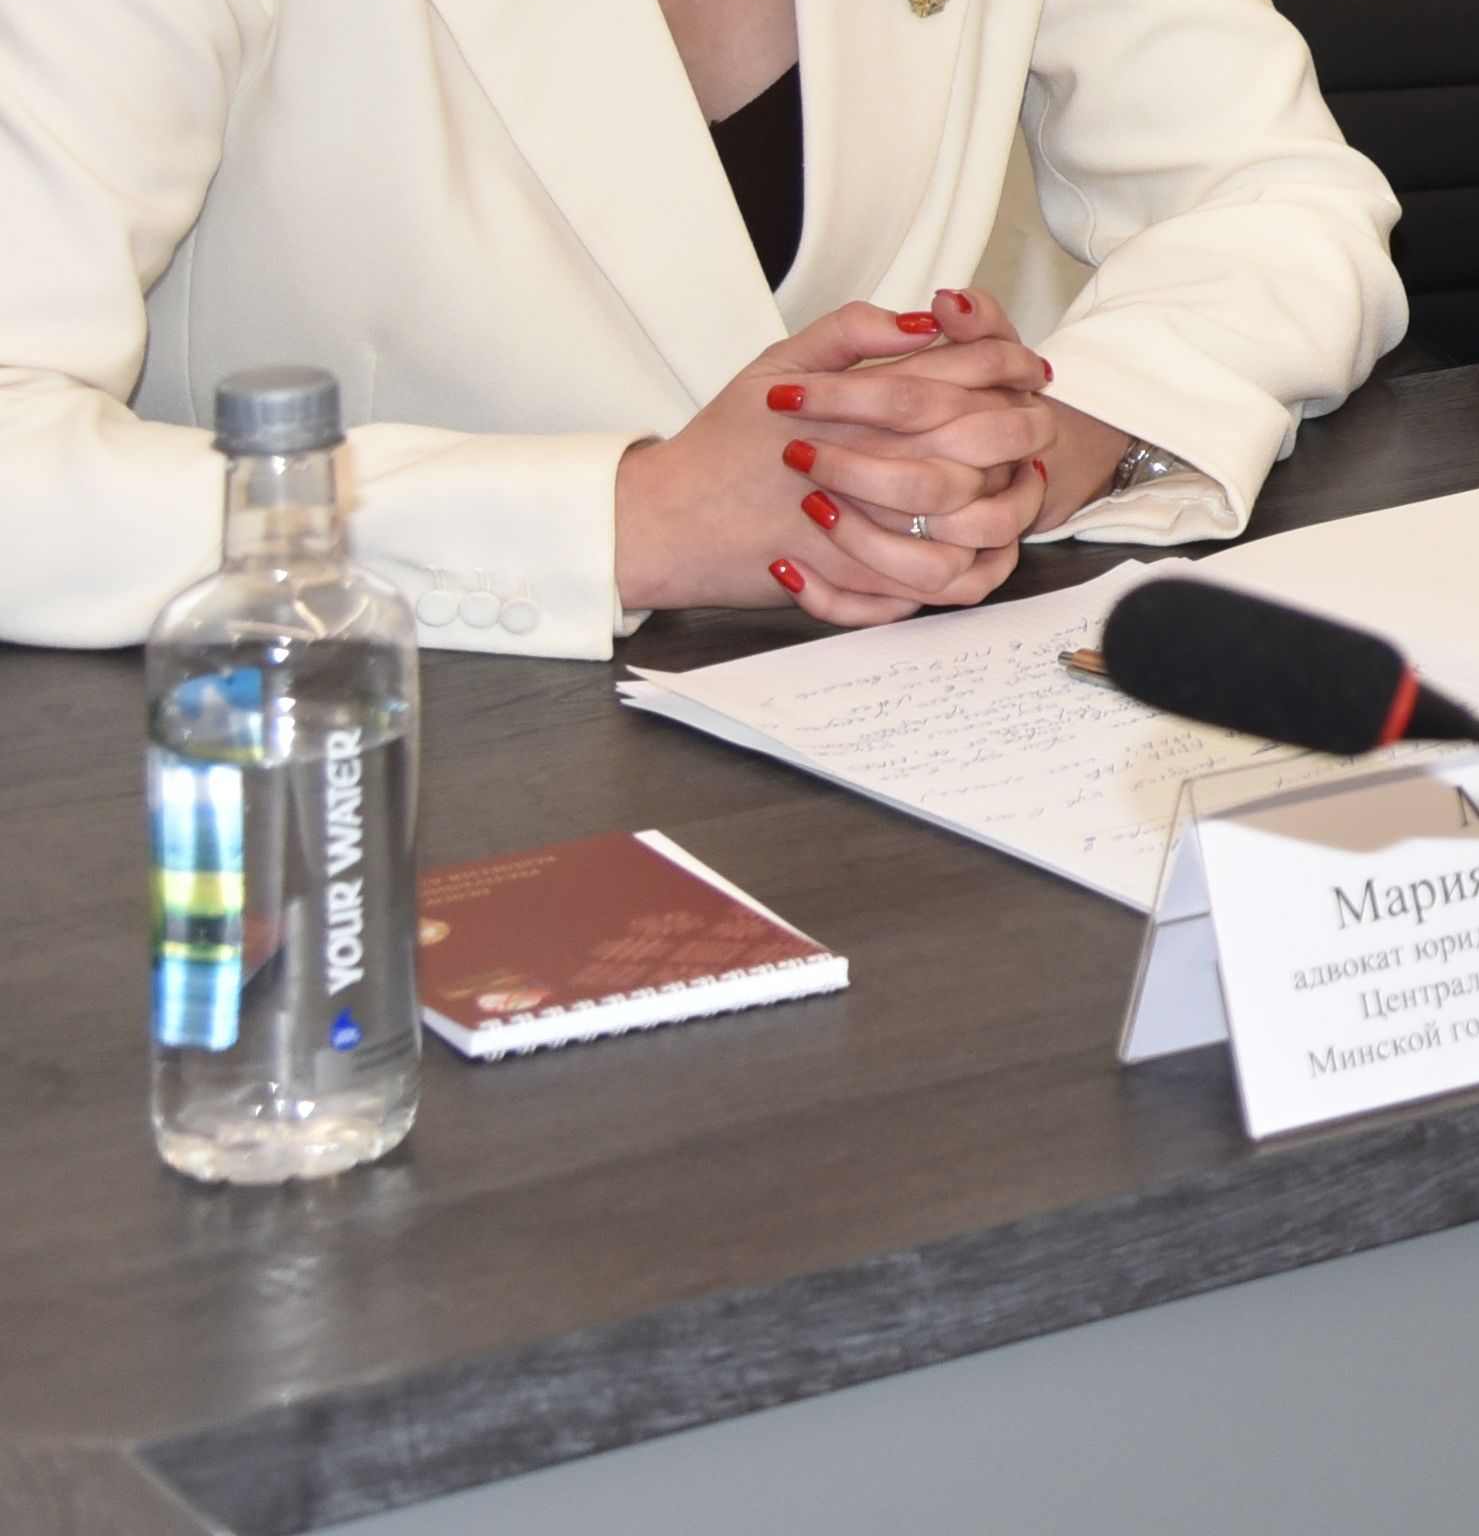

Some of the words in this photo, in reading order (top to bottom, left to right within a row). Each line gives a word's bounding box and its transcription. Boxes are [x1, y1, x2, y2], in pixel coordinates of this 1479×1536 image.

[324, 727, 363, 872] WATER
[327, 876, 364, 995] YOUR
[1293, 943, 1404, 992] адвокат
[1308, 1021, 1442, 1078] Минской
